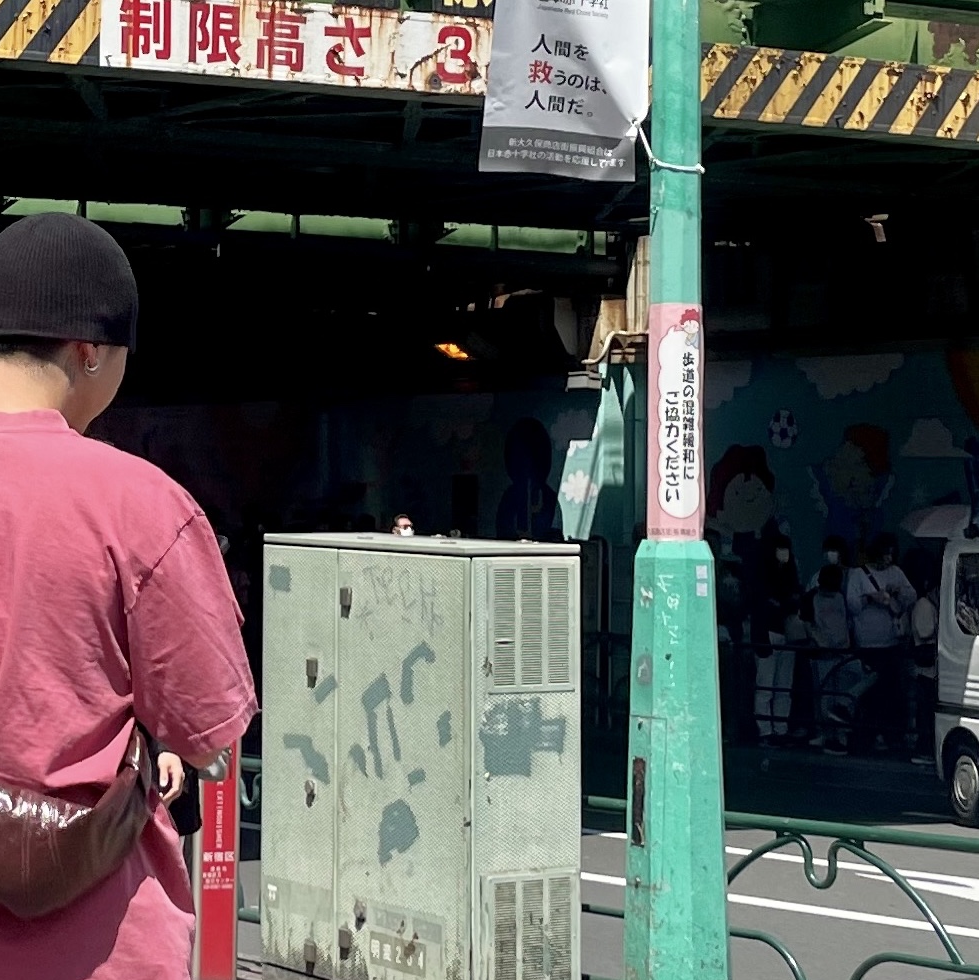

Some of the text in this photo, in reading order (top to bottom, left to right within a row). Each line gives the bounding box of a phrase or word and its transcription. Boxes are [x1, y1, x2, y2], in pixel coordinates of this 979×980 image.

[120, 1, 371, 77] 制限高さ
[531, 33, 589, 61] 人間を
[525, 90, 594, 118] 人間だ。
[528, 60, 607, 94] 救うのは、
[681, 351, 696, 481] 歩道の混雑緩和に
[665, 390, 680, 503] ご協力ください
